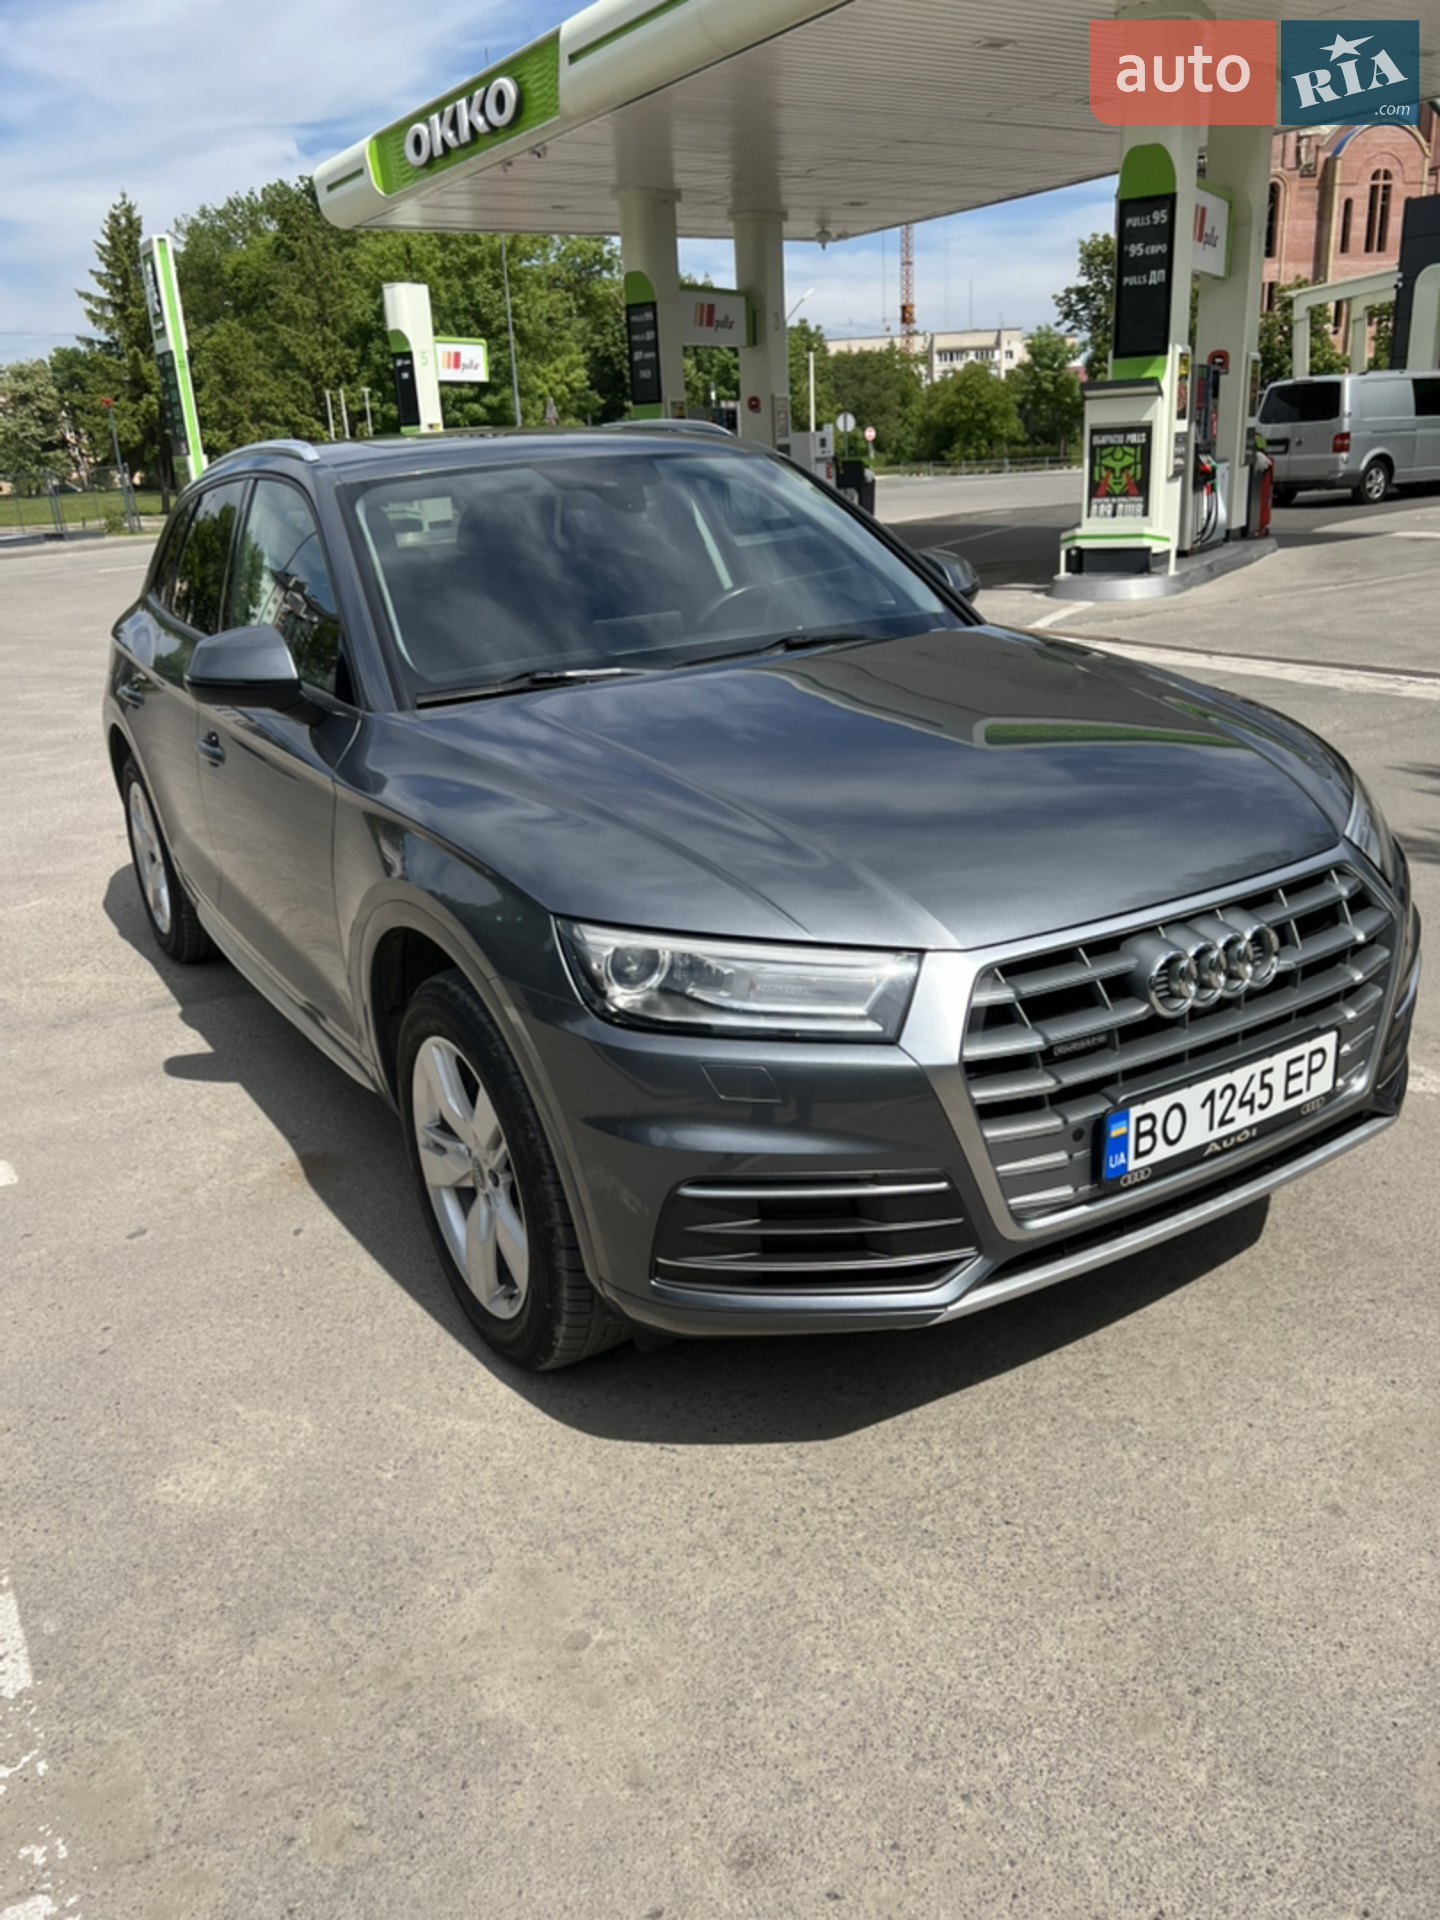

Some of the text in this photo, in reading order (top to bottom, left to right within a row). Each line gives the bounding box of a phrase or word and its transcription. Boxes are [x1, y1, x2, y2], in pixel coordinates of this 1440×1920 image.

[404, 76, 519, 167] OKKO
[1125, 209, 1168, 228] PULLS 95
[1134, 1046, 1328, 1160] BO 1245 EP
[1109, 1152, 1127, 1168] UA
